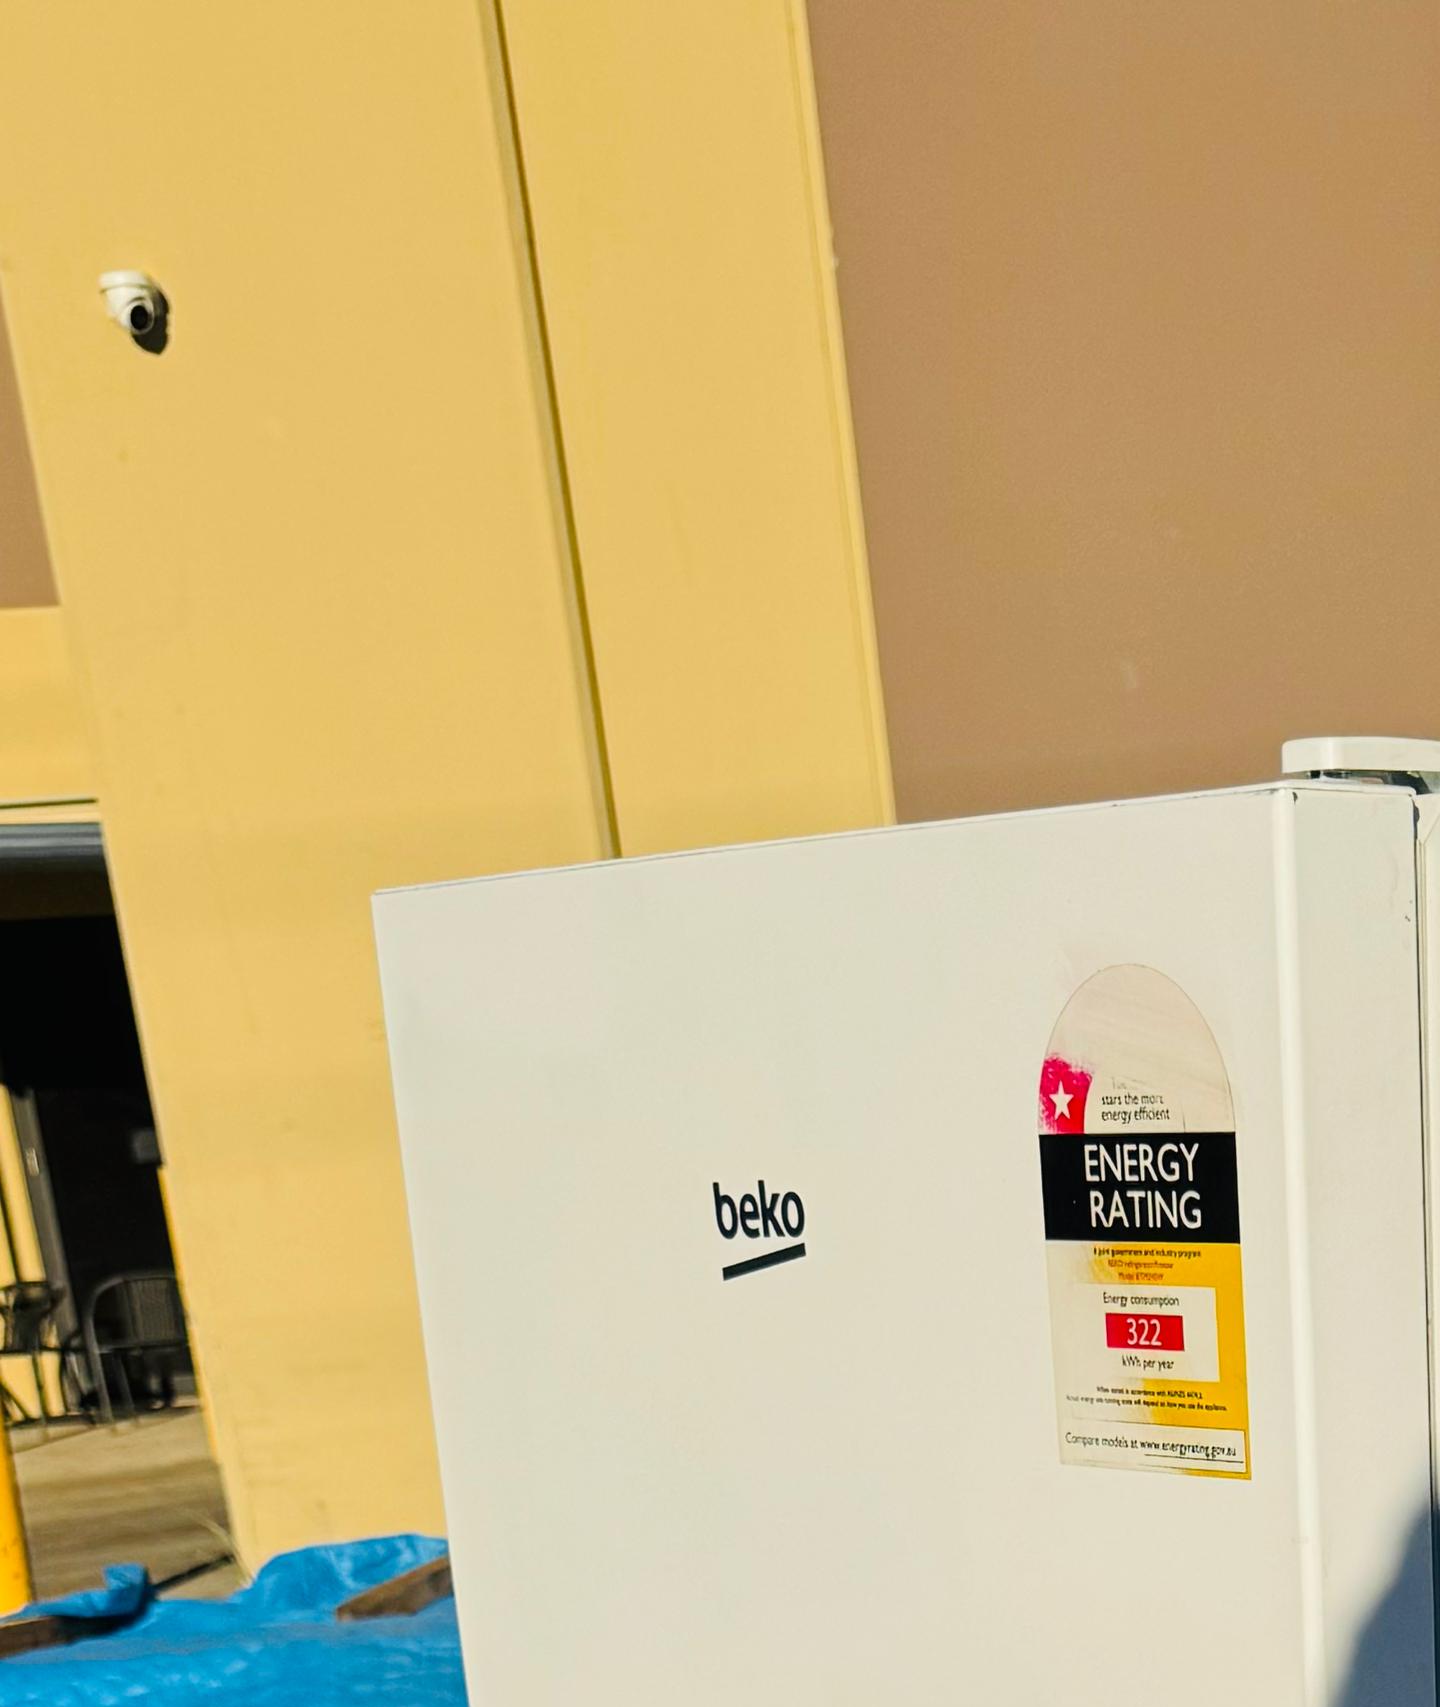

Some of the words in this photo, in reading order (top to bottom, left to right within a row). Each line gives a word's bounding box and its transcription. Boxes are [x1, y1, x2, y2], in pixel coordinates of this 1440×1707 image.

[1124, 1092, 1139, 1105] the
[1101, 1110, 1132, 1125] energy
[1083, 1143, 1199, 1182] ENERGY
[712, 1179, 805, 1240] beko
[1089, 1190, 1202, 1229] RATING
[1103, 1291, 1128, 1307] Energy
[1130, 1296, 1180, 1309] consumption
[1126, 1317, 1162, 1347] 322
[1143, 1359, 1156, 1371] per
[1157, 1360, 1175, 1372] year
[1065, 1431, 1100, 1448] Compare
[1102, 1436, 1129, 1449] models
[1130, 1439, 1139, 1449] at
